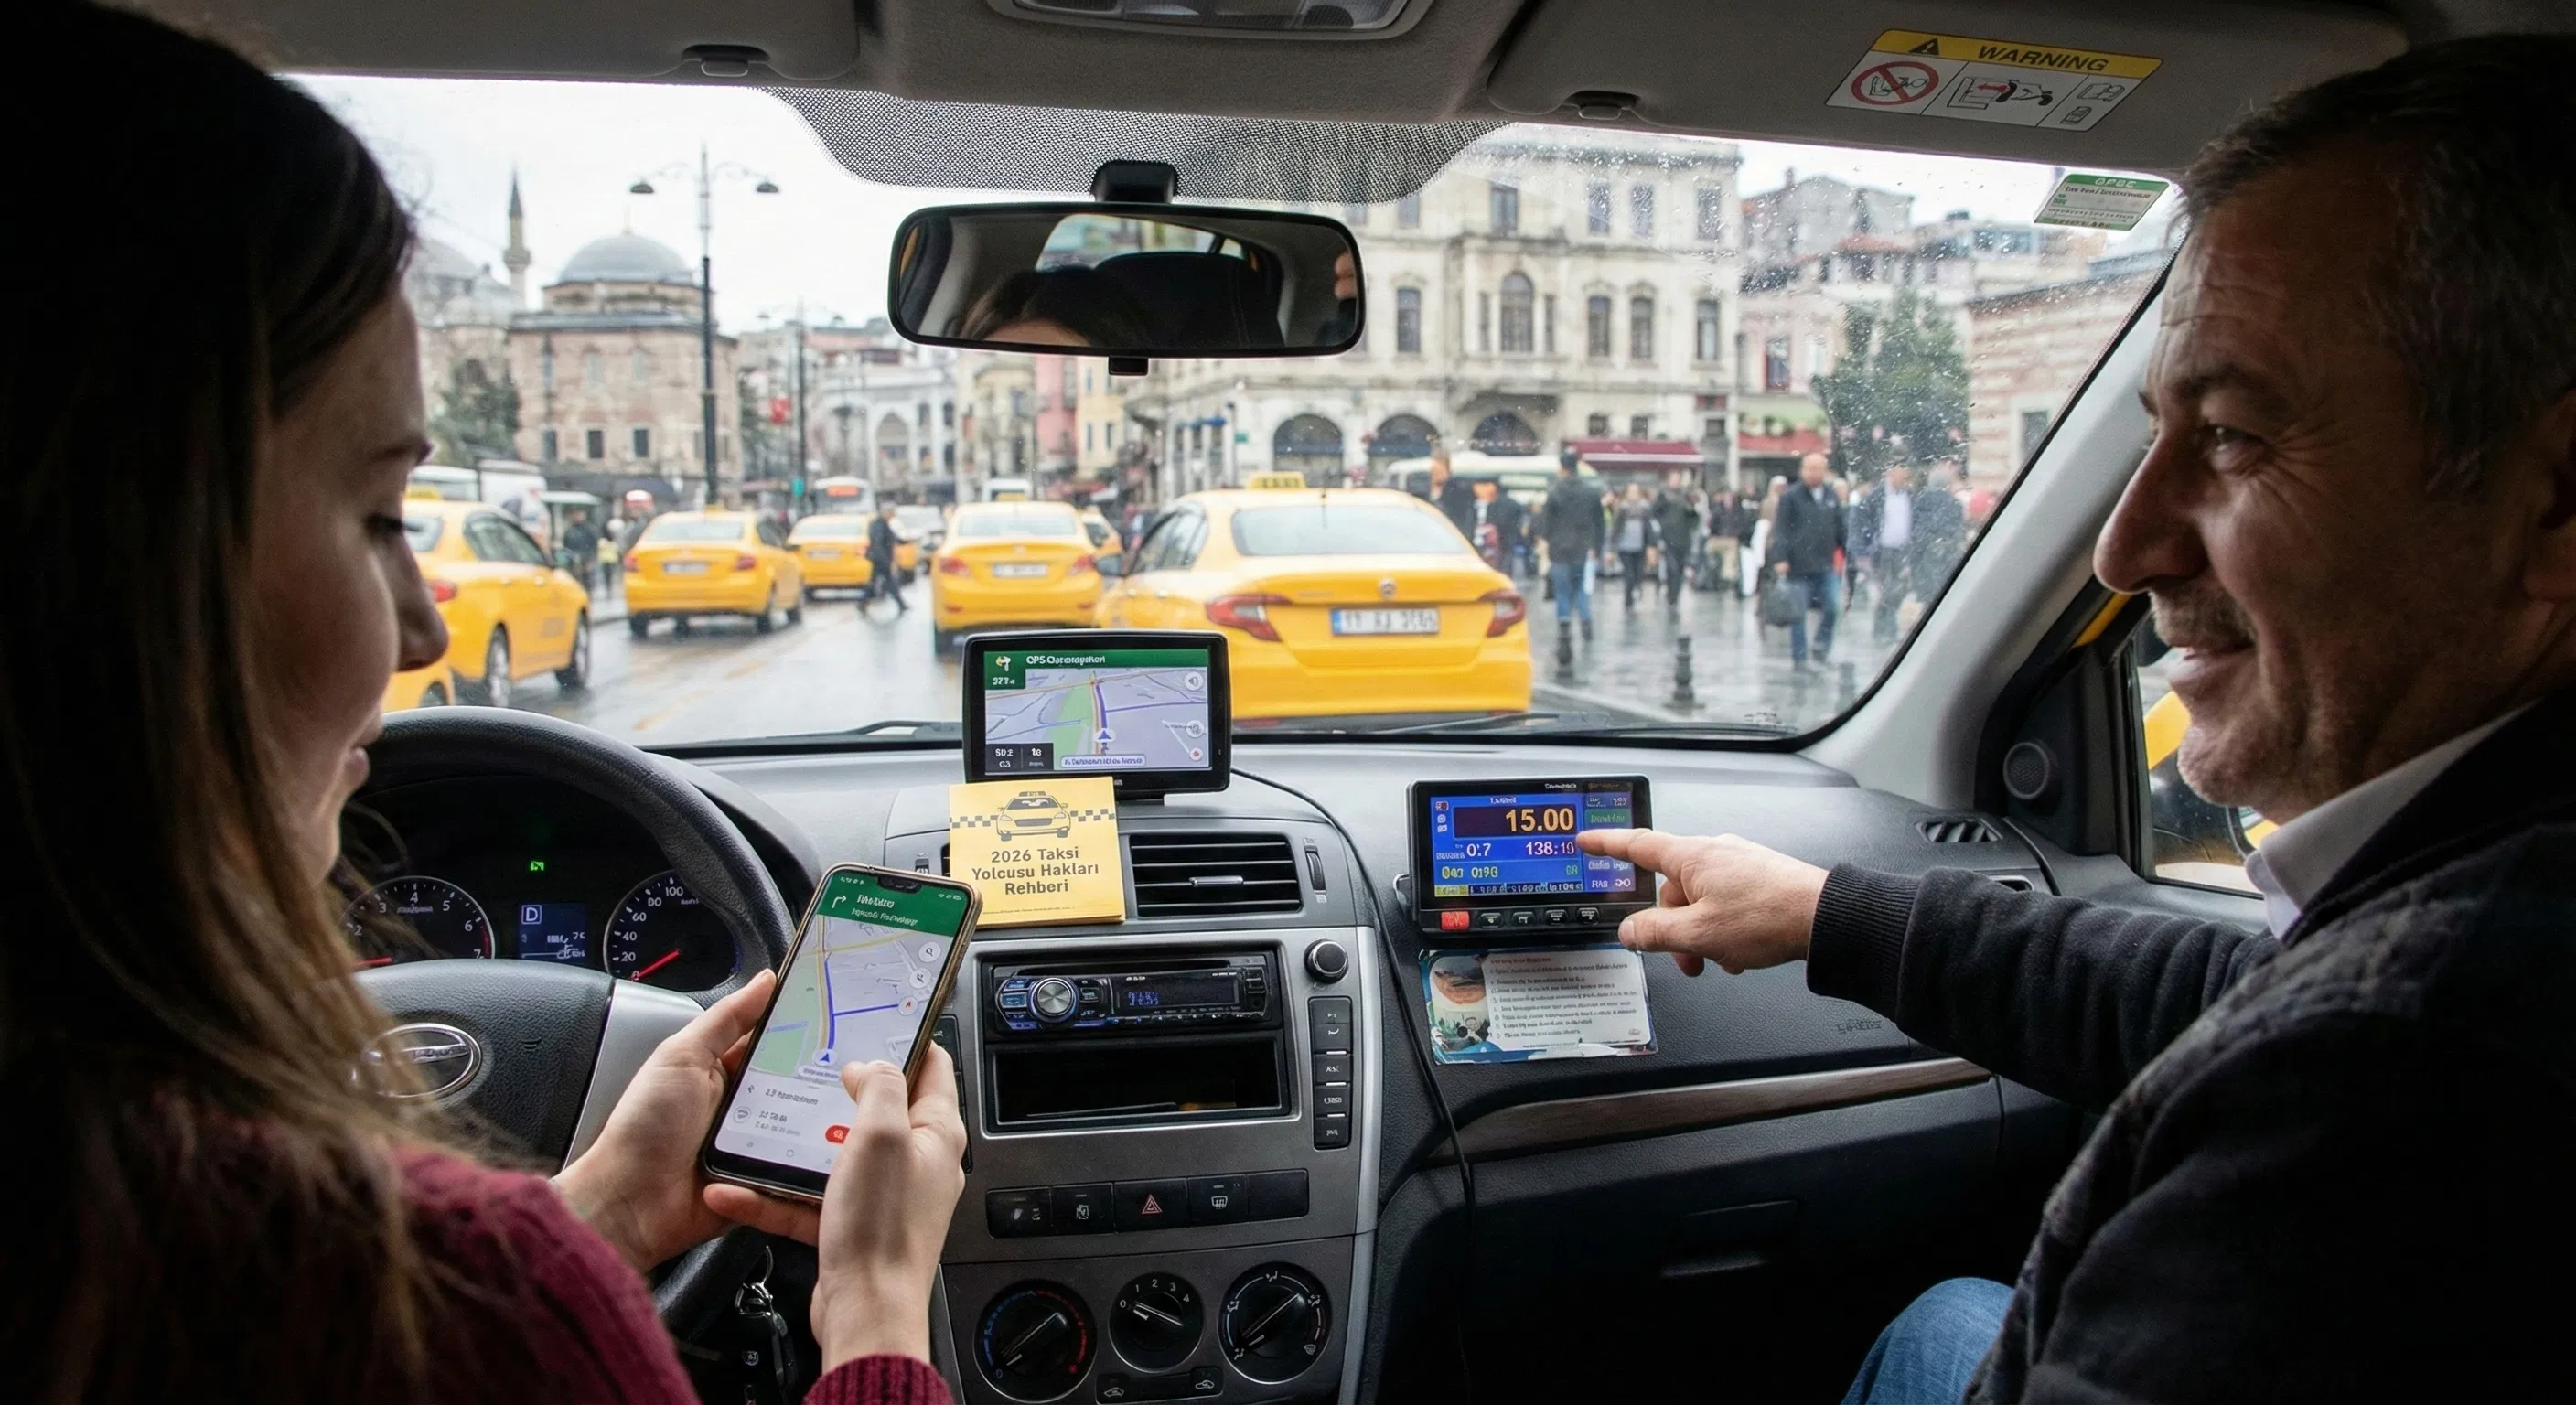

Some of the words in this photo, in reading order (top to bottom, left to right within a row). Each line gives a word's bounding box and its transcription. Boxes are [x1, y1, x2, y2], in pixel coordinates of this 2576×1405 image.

[1978, 45, 2109, 72] WARNING
[1506, 808, 1574, 832] 15.00
[991, 849, 1032, 863] 2026
[1037, 846, 1079, 862] Taksi
[971, 866, 1035, 880] Yolcusu
[1041, 863, 1099, 877] Hakları
[665, 886, 684, 896] 100
[1004, 879, 1068, 896] Rehberi
[410, 892, 419, 903] 4
[379, 902, 387, 913] 3
[442, 900, 450, 911] 5
[525, 906, 539, 922] D
[632, 912, 647, 922] 60
[464, 921, 473, 931] 6
[622, 931, 638, 941] 40
[621, 951, 636, 961] 20
[1135, 1284, 1140, 1292] 1
[1151, 1278, 1158, 1288] 2
[1170, 1282, 1176, 1292] 3
[1183, 1293, 1190, 1303] 4
[1119, 1299, 1127, 1308] 0
